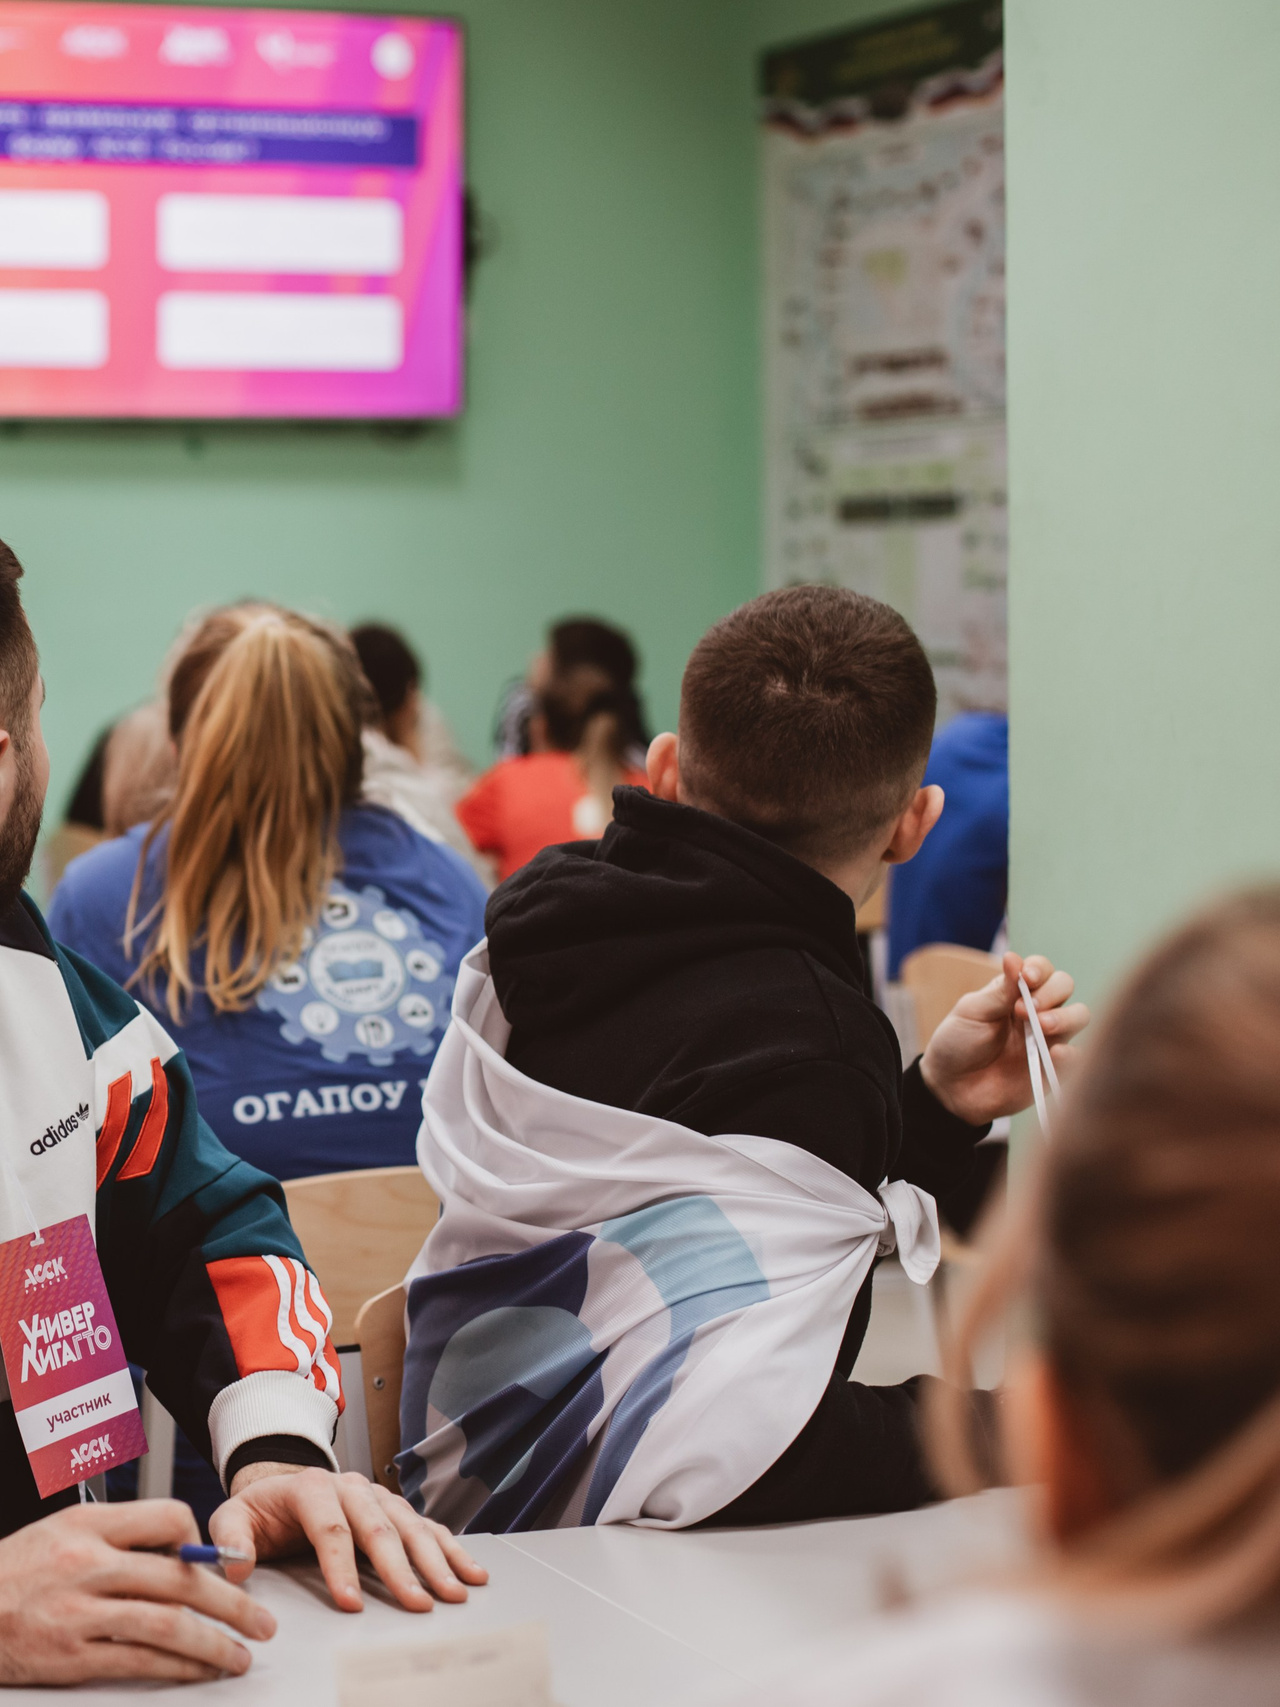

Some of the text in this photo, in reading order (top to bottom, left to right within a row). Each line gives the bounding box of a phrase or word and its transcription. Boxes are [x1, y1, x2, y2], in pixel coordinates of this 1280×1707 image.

[232, 1080, 408, 1125] ОГАПОУ
[30, 1114, 79, 1156] adidas
[18, 1301, 95, 1350] УНИВЕР
[46, 1392, 112, 1433] участник
